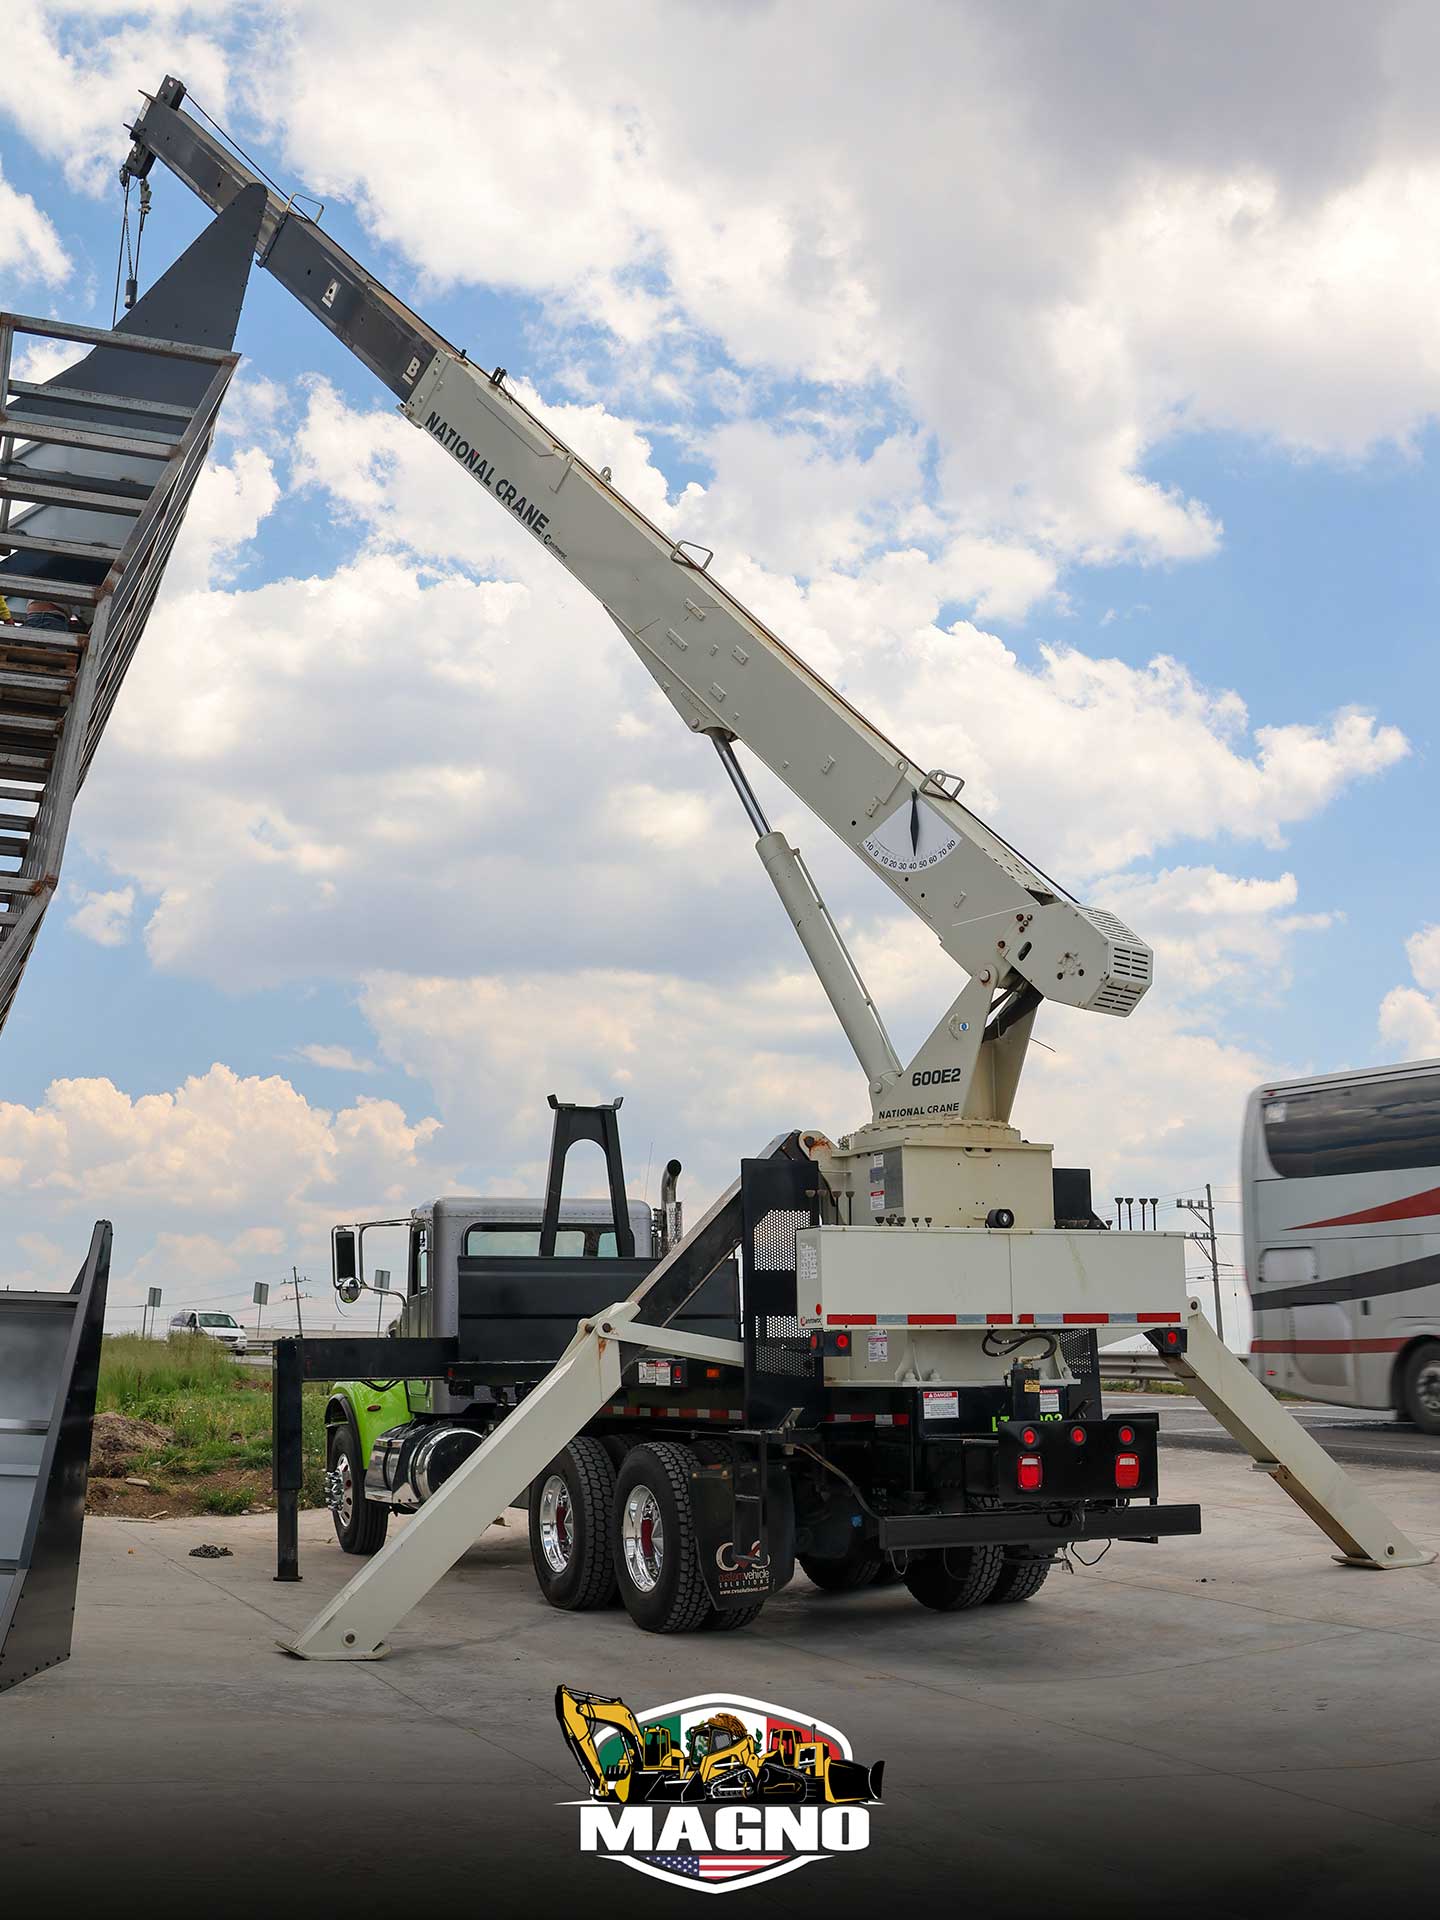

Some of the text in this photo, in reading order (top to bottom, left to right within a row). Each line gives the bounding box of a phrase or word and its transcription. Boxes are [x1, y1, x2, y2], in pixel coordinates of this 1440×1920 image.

[324, 281, 338, 302] A
[406, 356, 420, 377] B
[424, 411, 550, 535] NATIONAL CRANE
[865, 840, 874, 851] -10
[881, 856, 889, 865] 10
[888, 860, 897, 868] 20
[919, 859, 927, 868] 50
[928, 855, 938, 864] 60
[938, 848, 947, 858] 70
[946, 839, 956, 850] 80
[912, 1068, 961, 1087] 600E2
[879, 1102, 960, 1119] NATIONAL CRANE
